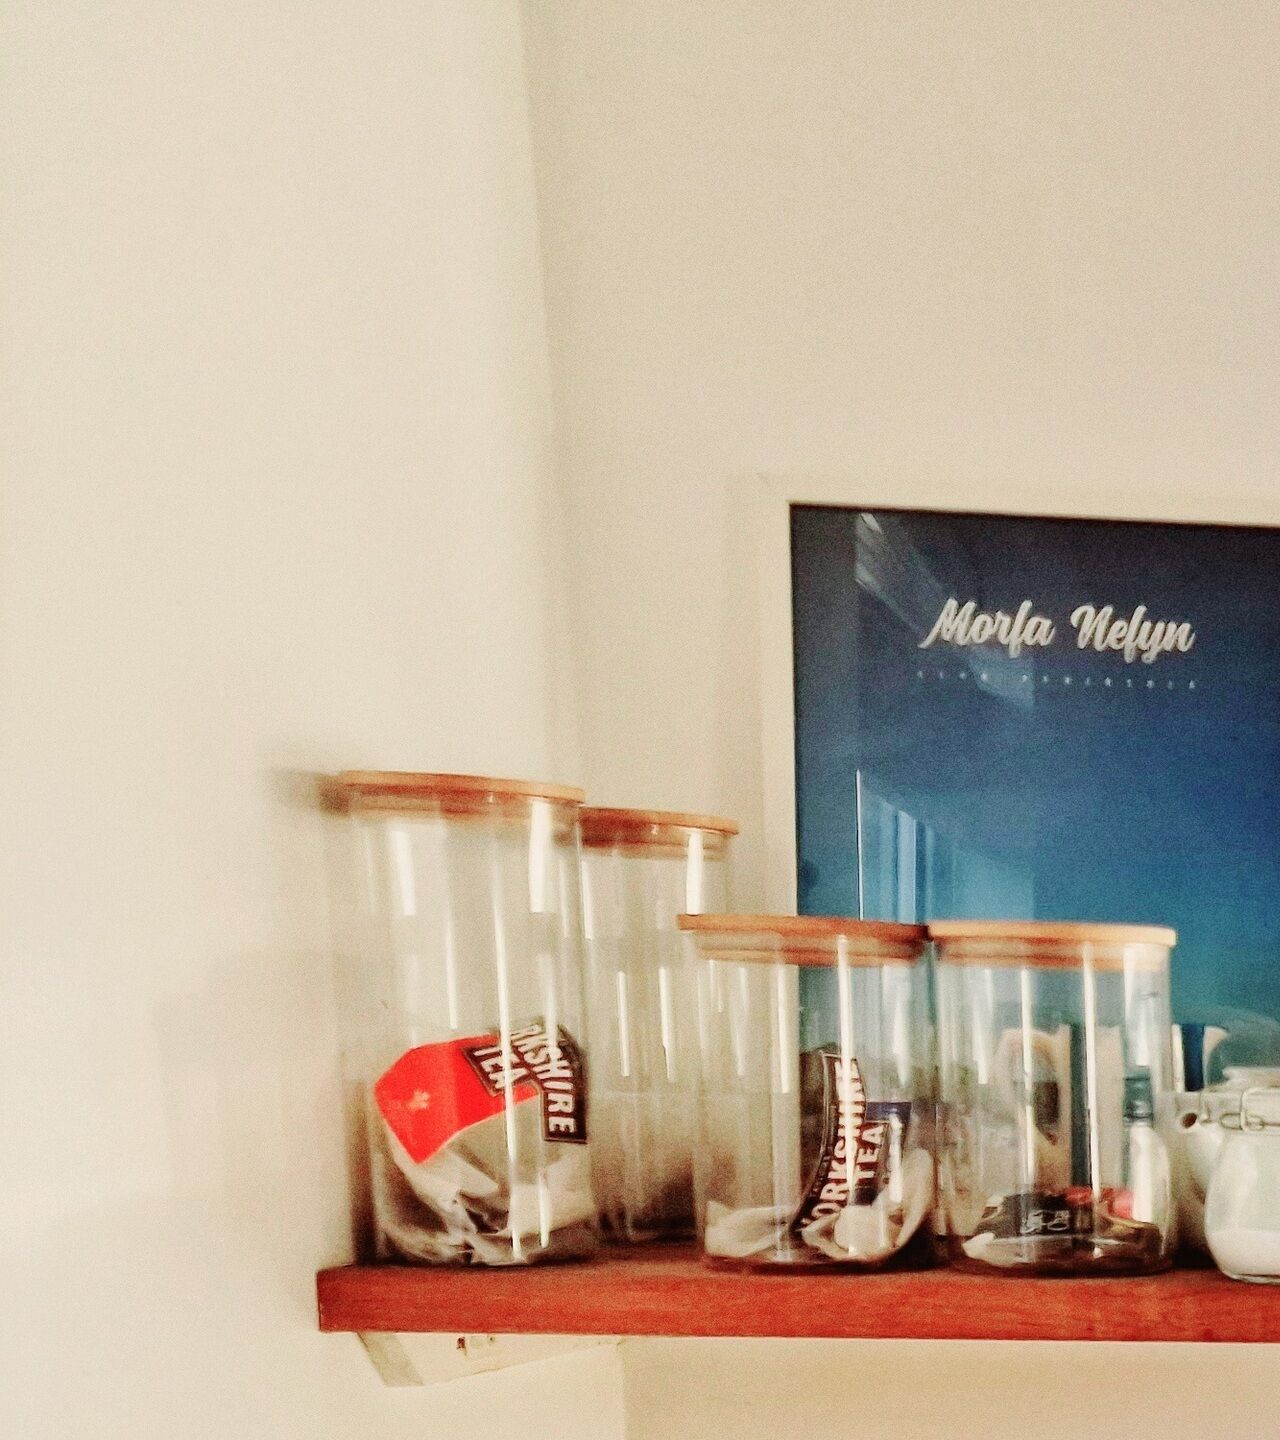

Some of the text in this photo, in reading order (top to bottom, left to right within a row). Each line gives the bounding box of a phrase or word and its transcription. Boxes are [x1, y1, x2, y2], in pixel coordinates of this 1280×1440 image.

[918, 597, 1195, 664] Morfa Nefyn
[854, 1125, 885, 1180] TEA
